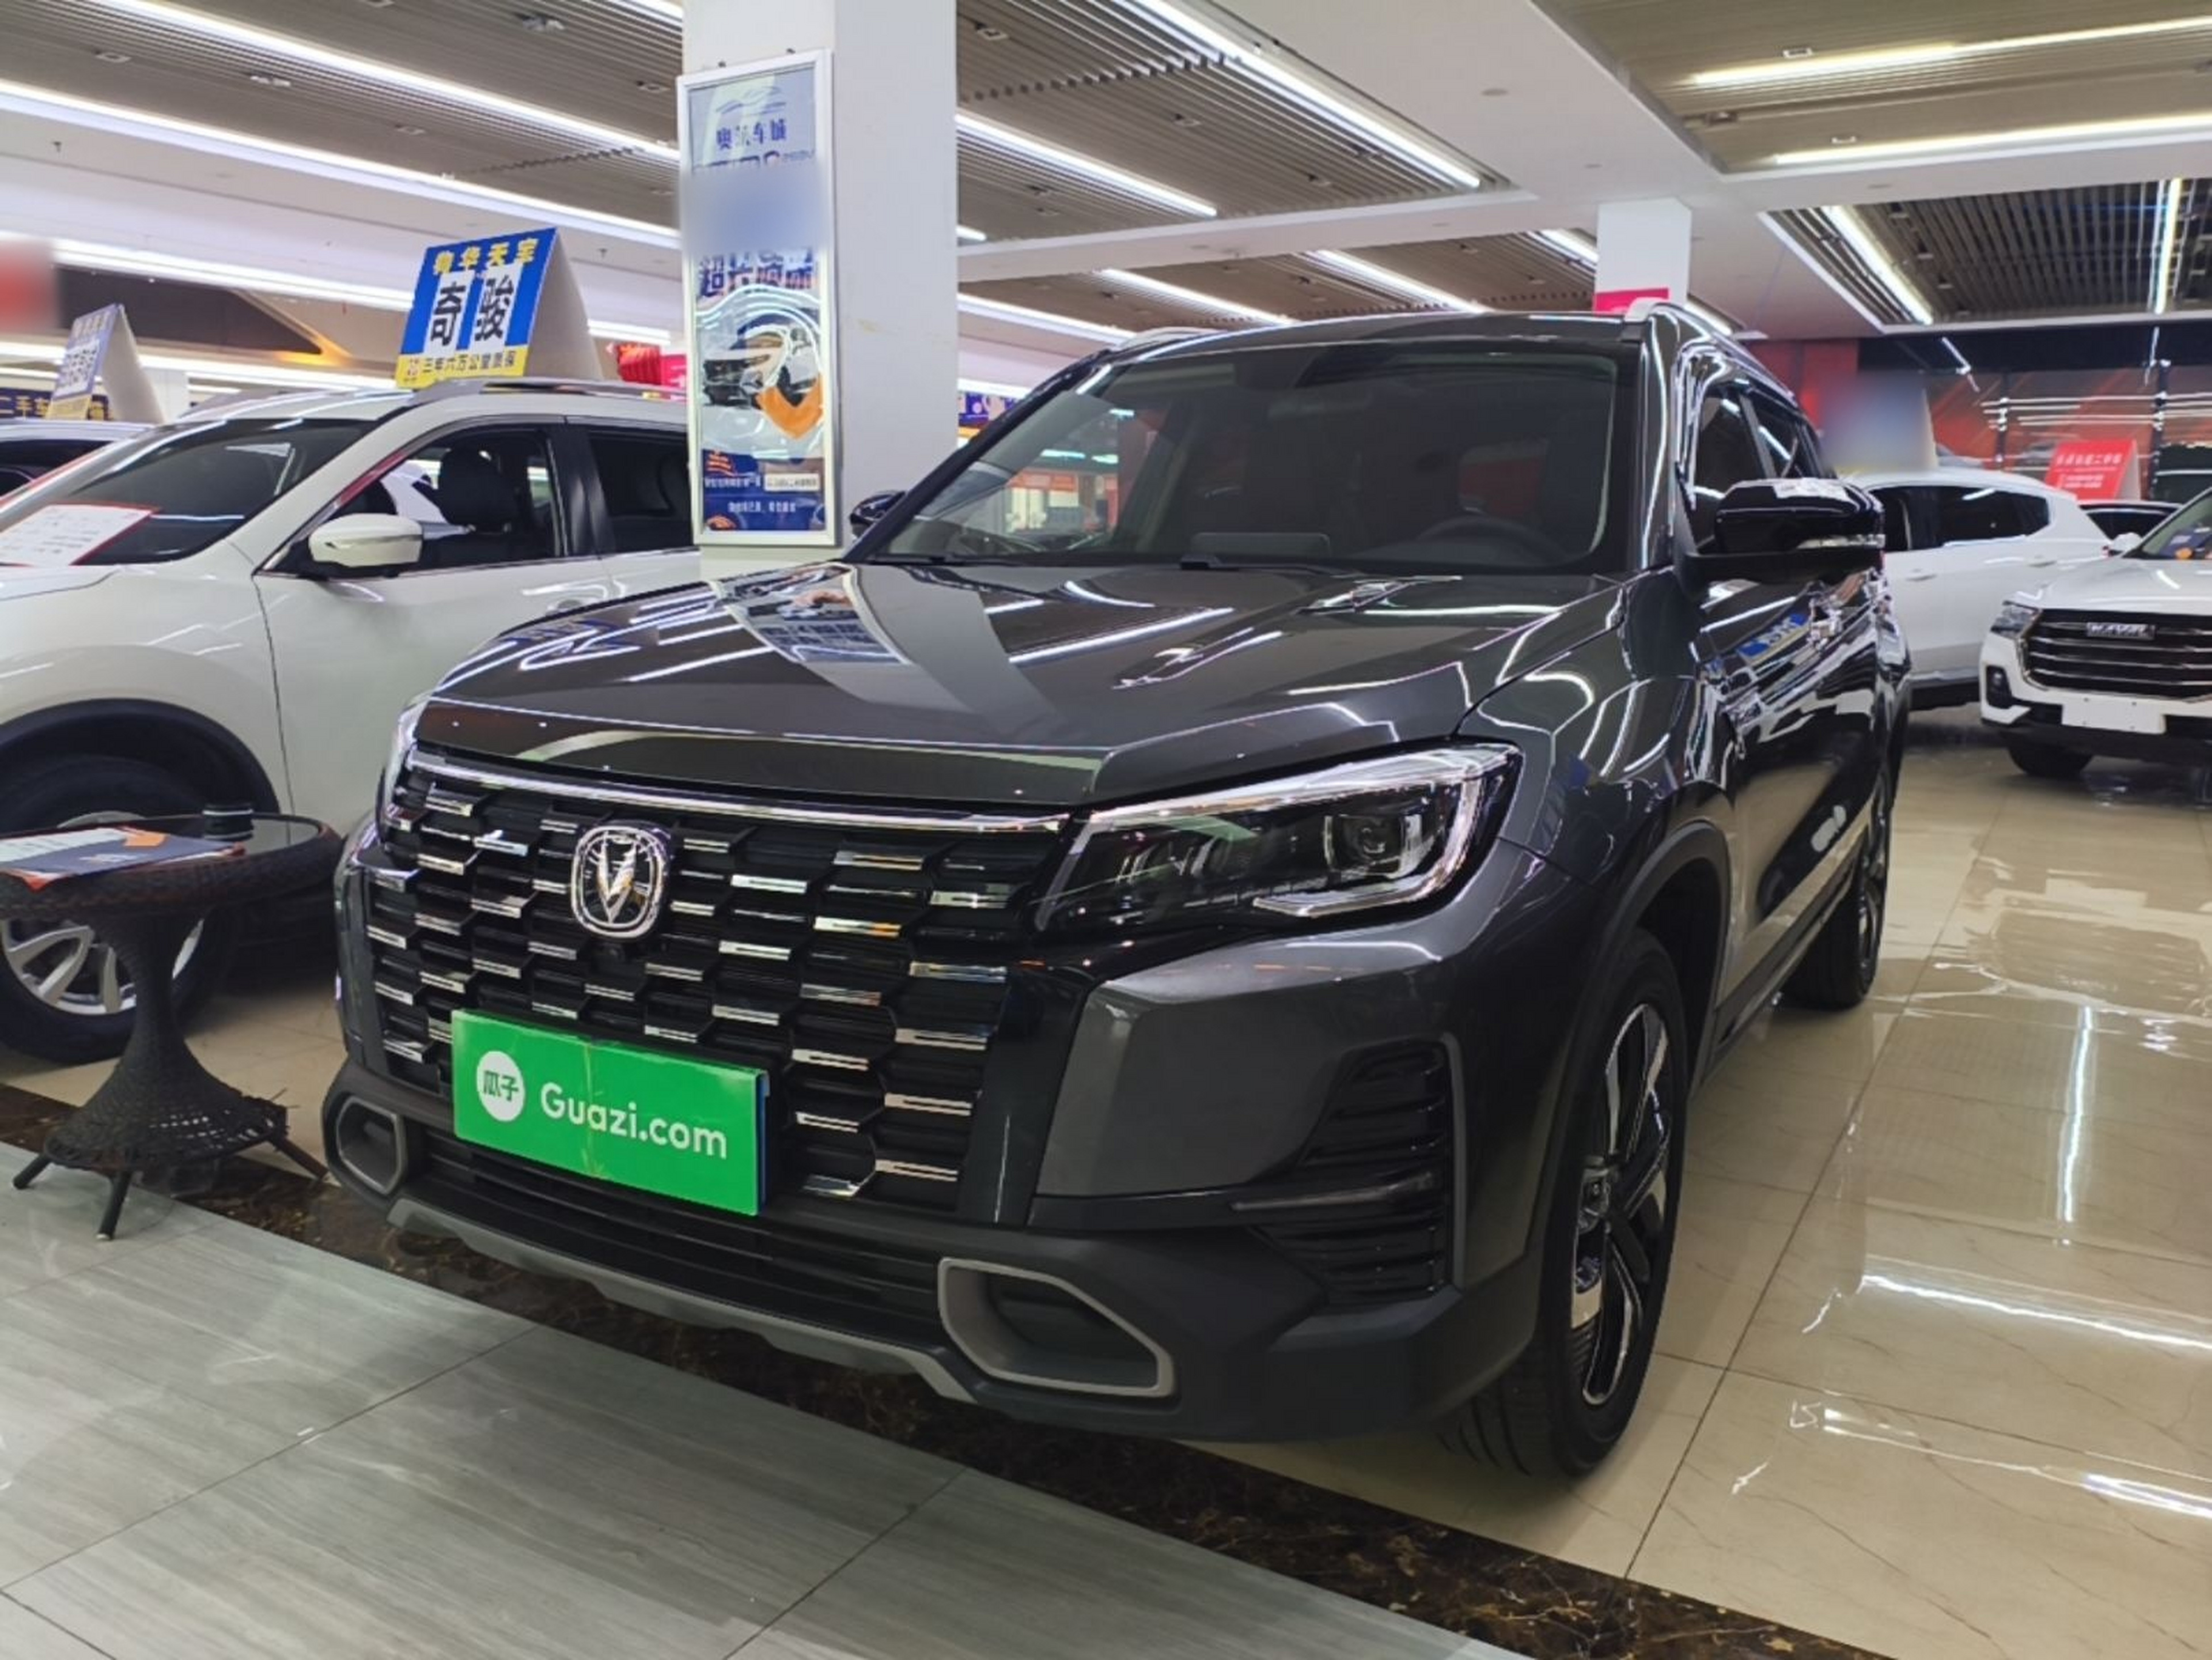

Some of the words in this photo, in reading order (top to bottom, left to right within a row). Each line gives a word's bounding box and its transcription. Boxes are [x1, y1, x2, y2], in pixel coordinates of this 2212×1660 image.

[430, 274, 514, 346] 奇骏
[482, 1069, 519, 1102] 瓜子
[540, 1082, 727, 1159] Guazi.com
